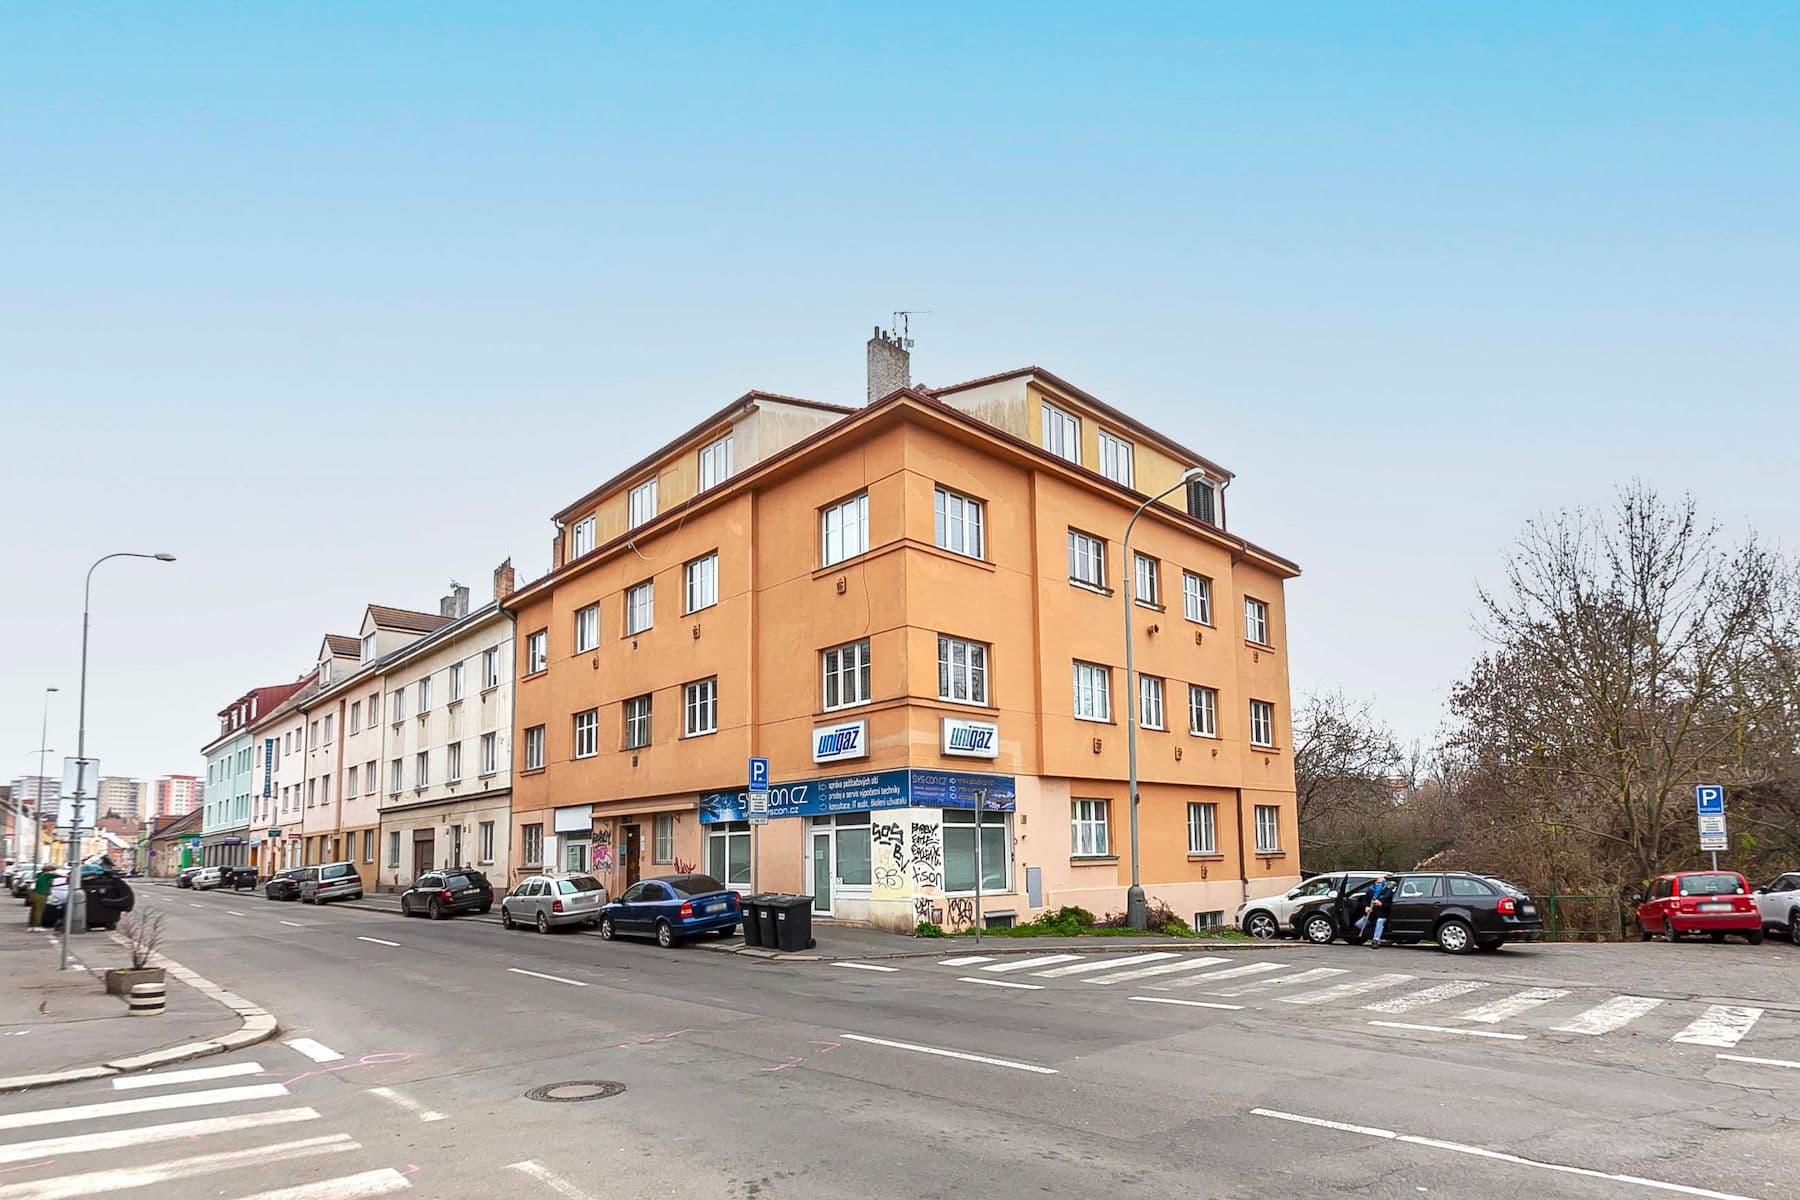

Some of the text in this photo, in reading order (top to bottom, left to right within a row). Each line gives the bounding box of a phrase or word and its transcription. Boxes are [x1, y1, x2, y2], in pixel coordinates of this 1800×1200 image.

[816, 726, 860, 757] unigaz
[949, 725, 993, 751] unigaz
[753, 761, 765, 782] P
[791, 786, 808, 804] CZ
[1702, 789, 1717, 806] P
